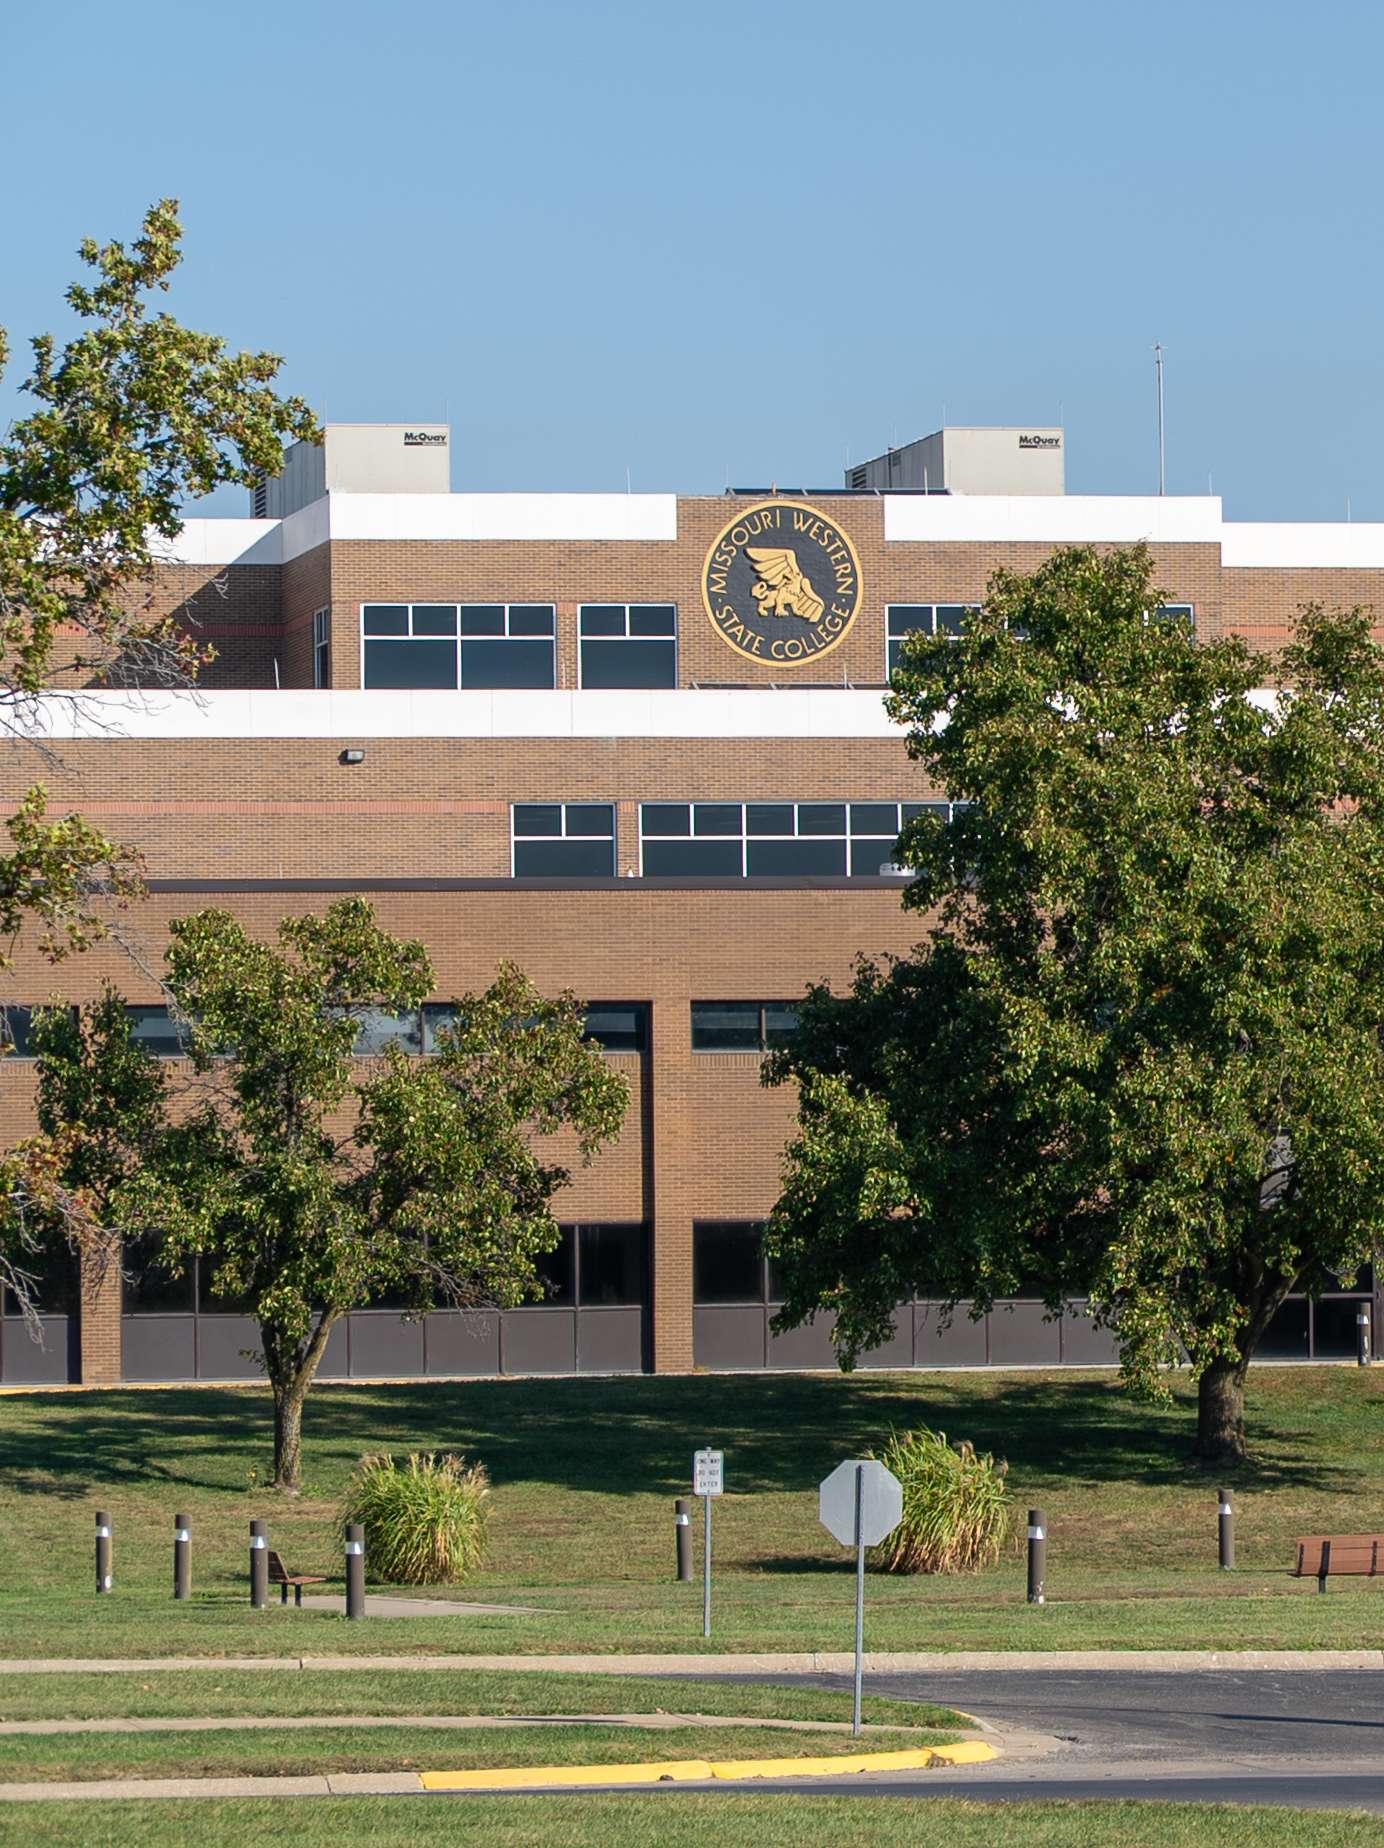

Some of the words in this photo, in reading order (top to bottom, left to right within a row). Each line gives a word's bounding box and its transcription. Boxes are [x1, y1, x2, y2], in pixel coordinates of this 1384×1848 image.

[404, 432, 446, 441] McQuay
[1019, 435, 1060, 445] McQuay
[710, 509, 781, 594] MISSOURI
[793, 511, 854, 594] WESTERN
[716, 605, 765, 655] STATE
[771, 603, 850, 659] COLLEGE
